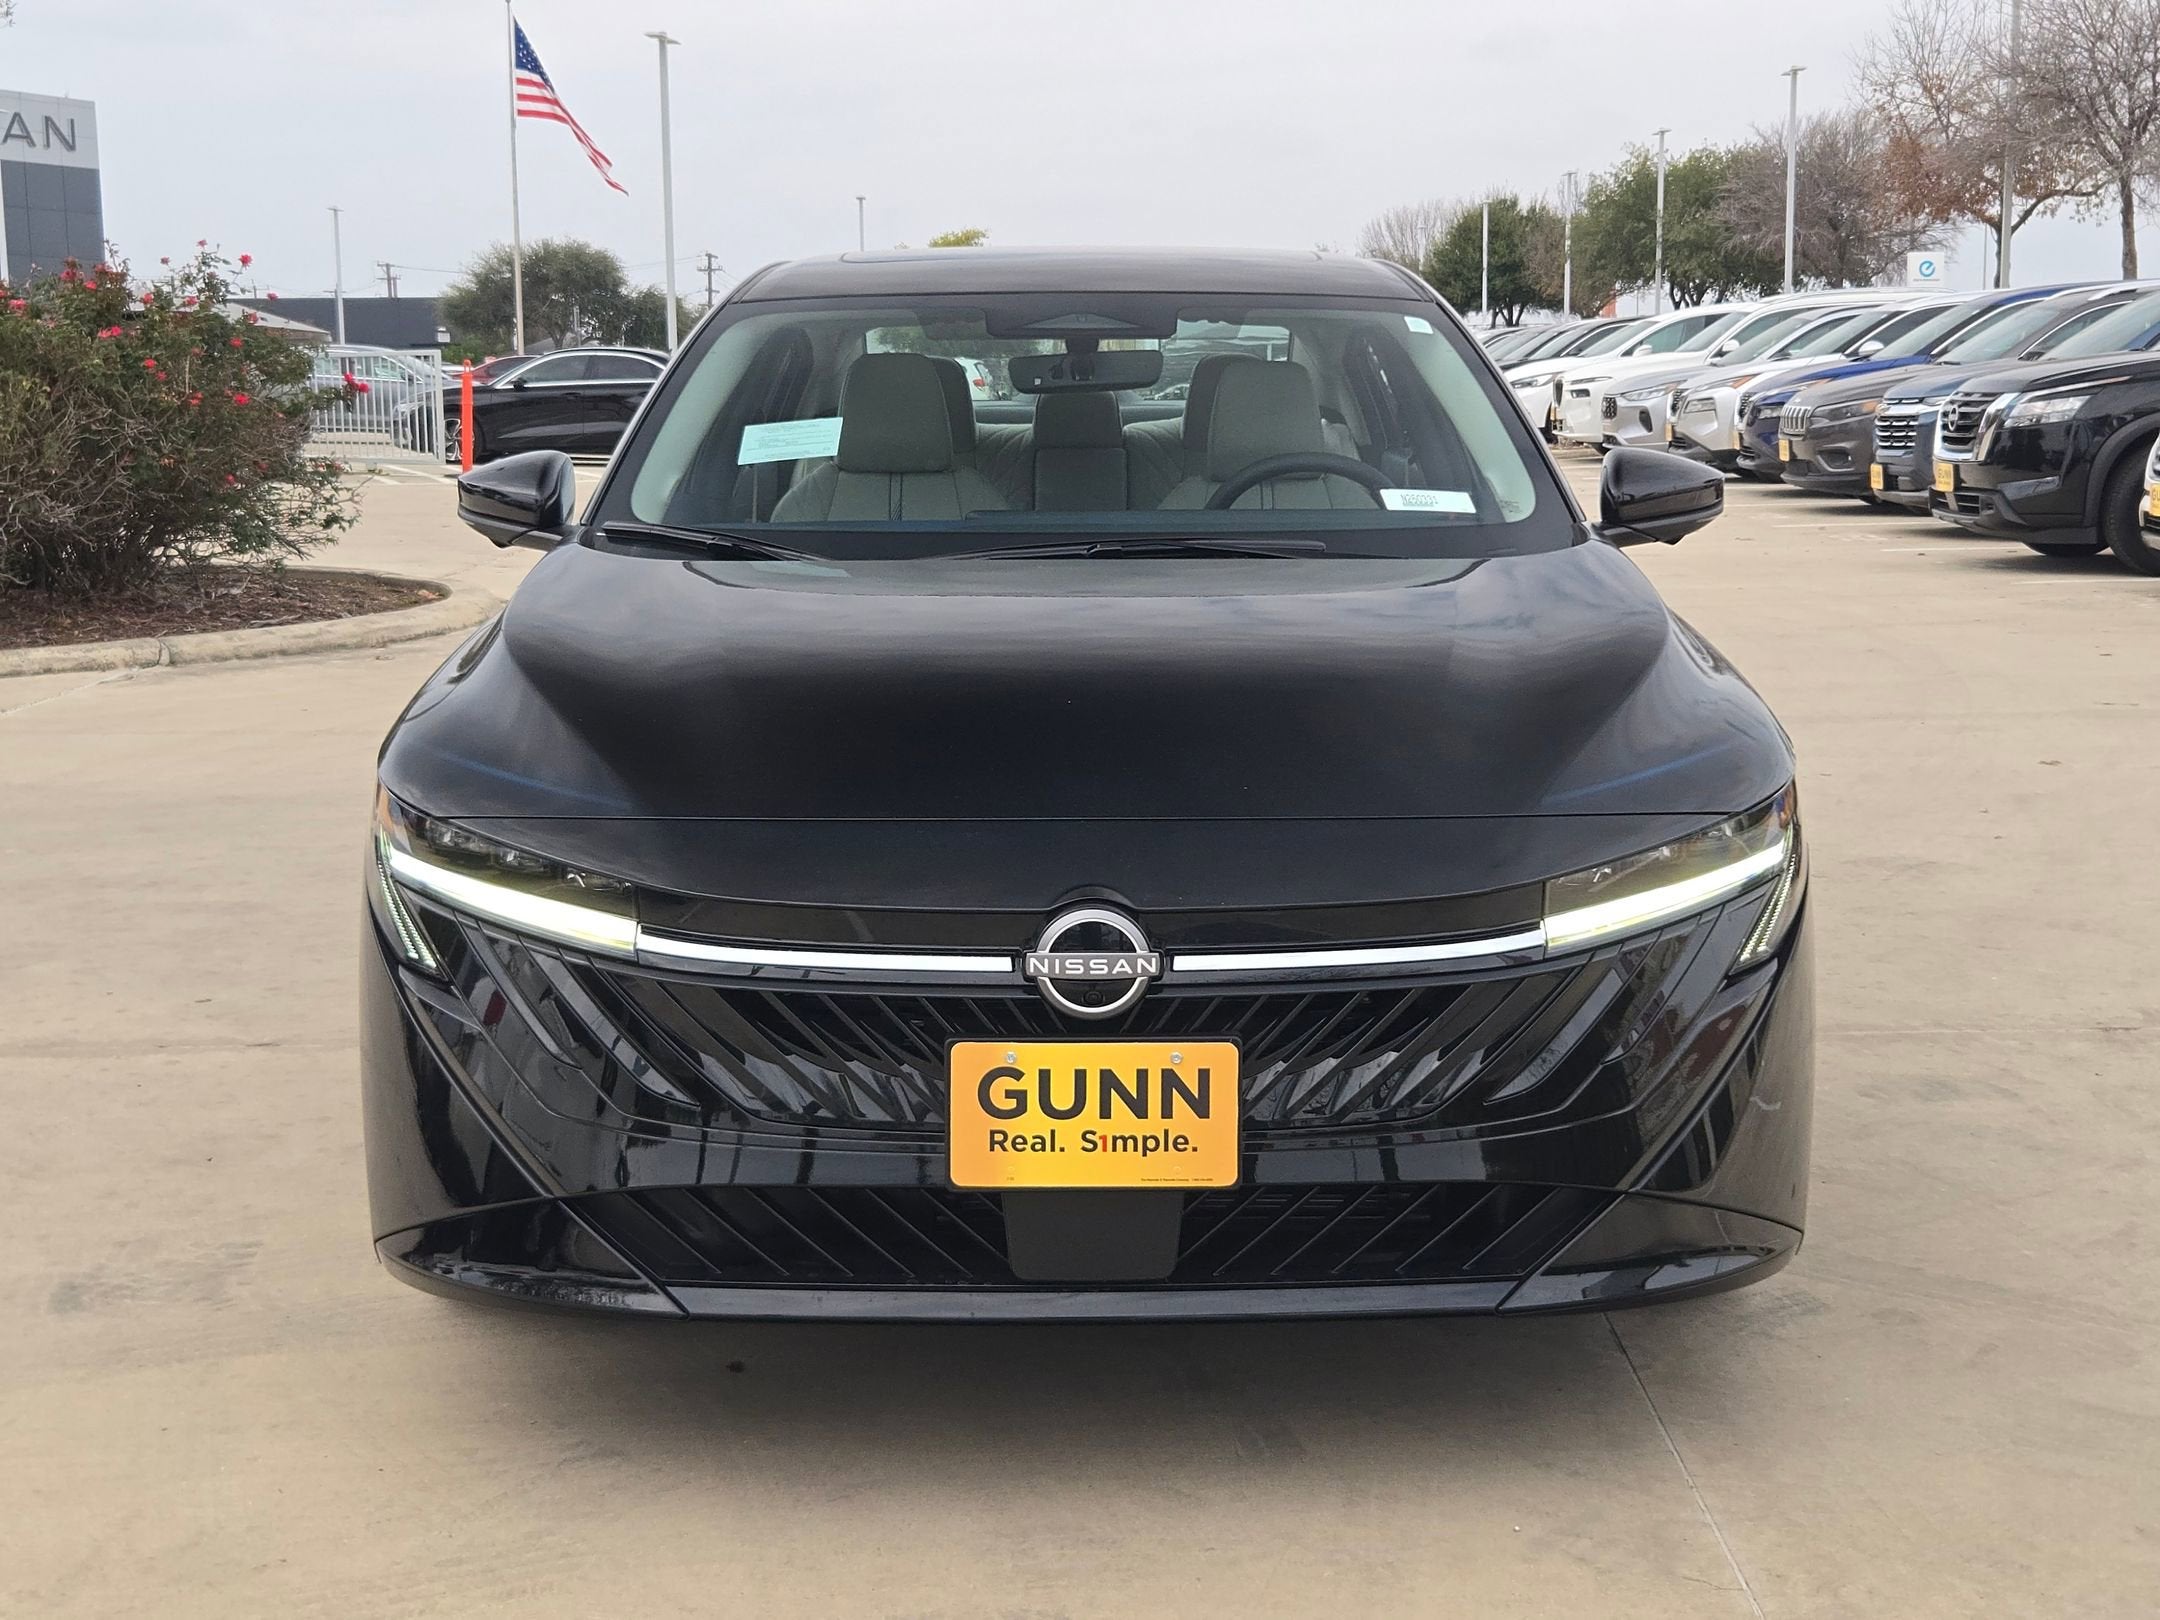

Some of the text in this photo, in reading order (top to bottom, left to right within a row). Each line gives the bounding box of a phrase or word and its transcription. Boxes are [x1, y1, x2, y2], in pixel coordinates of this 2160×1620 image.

[0, 111, 77, 152] AN
[1029, 957, 1157, 975] NISSAN
[977, 1066, 1211, 1121] GUNN
[989, 1129, 1065, 1153] Real.
